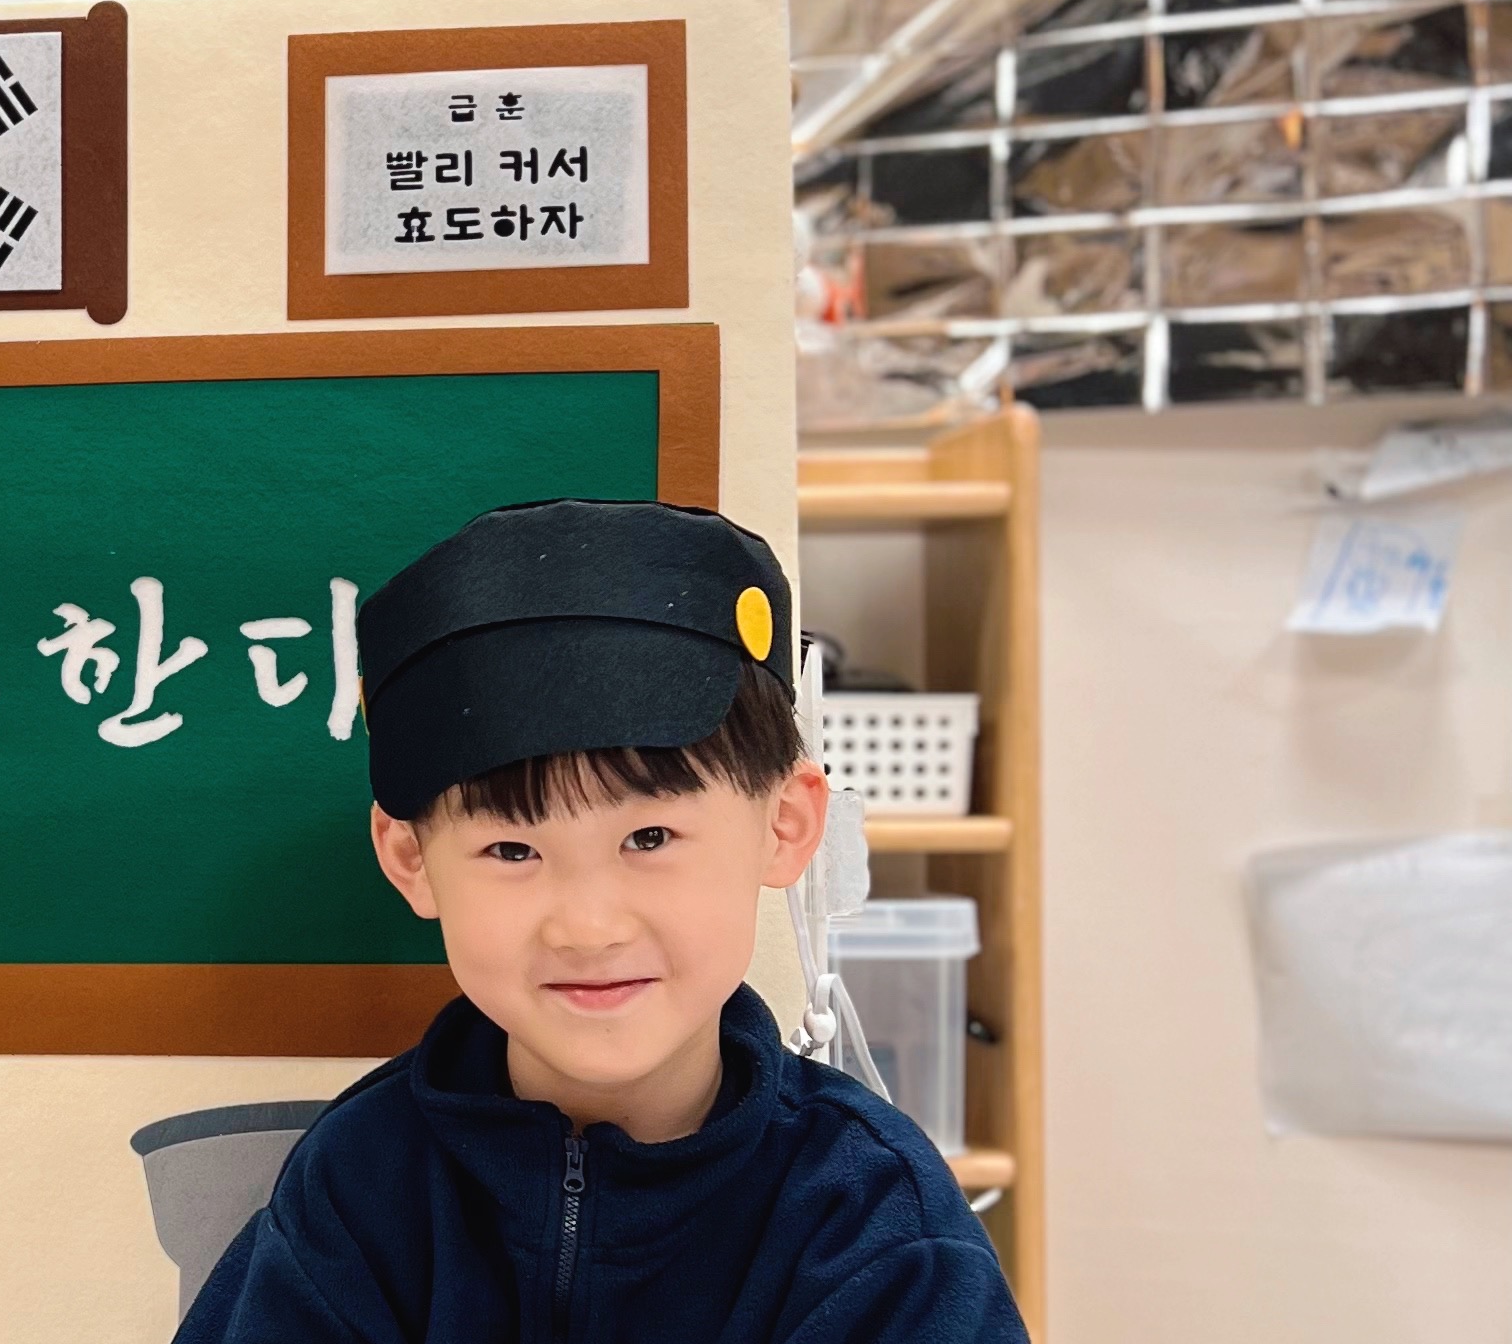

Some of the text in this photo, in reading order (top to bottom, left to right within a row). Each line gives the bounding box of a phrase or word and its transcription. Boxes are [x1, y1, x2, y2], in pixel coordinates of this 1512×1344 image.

[385, 144, 589, 192] 빨리 커서
[393, 201, 585, 244] 효도하자
